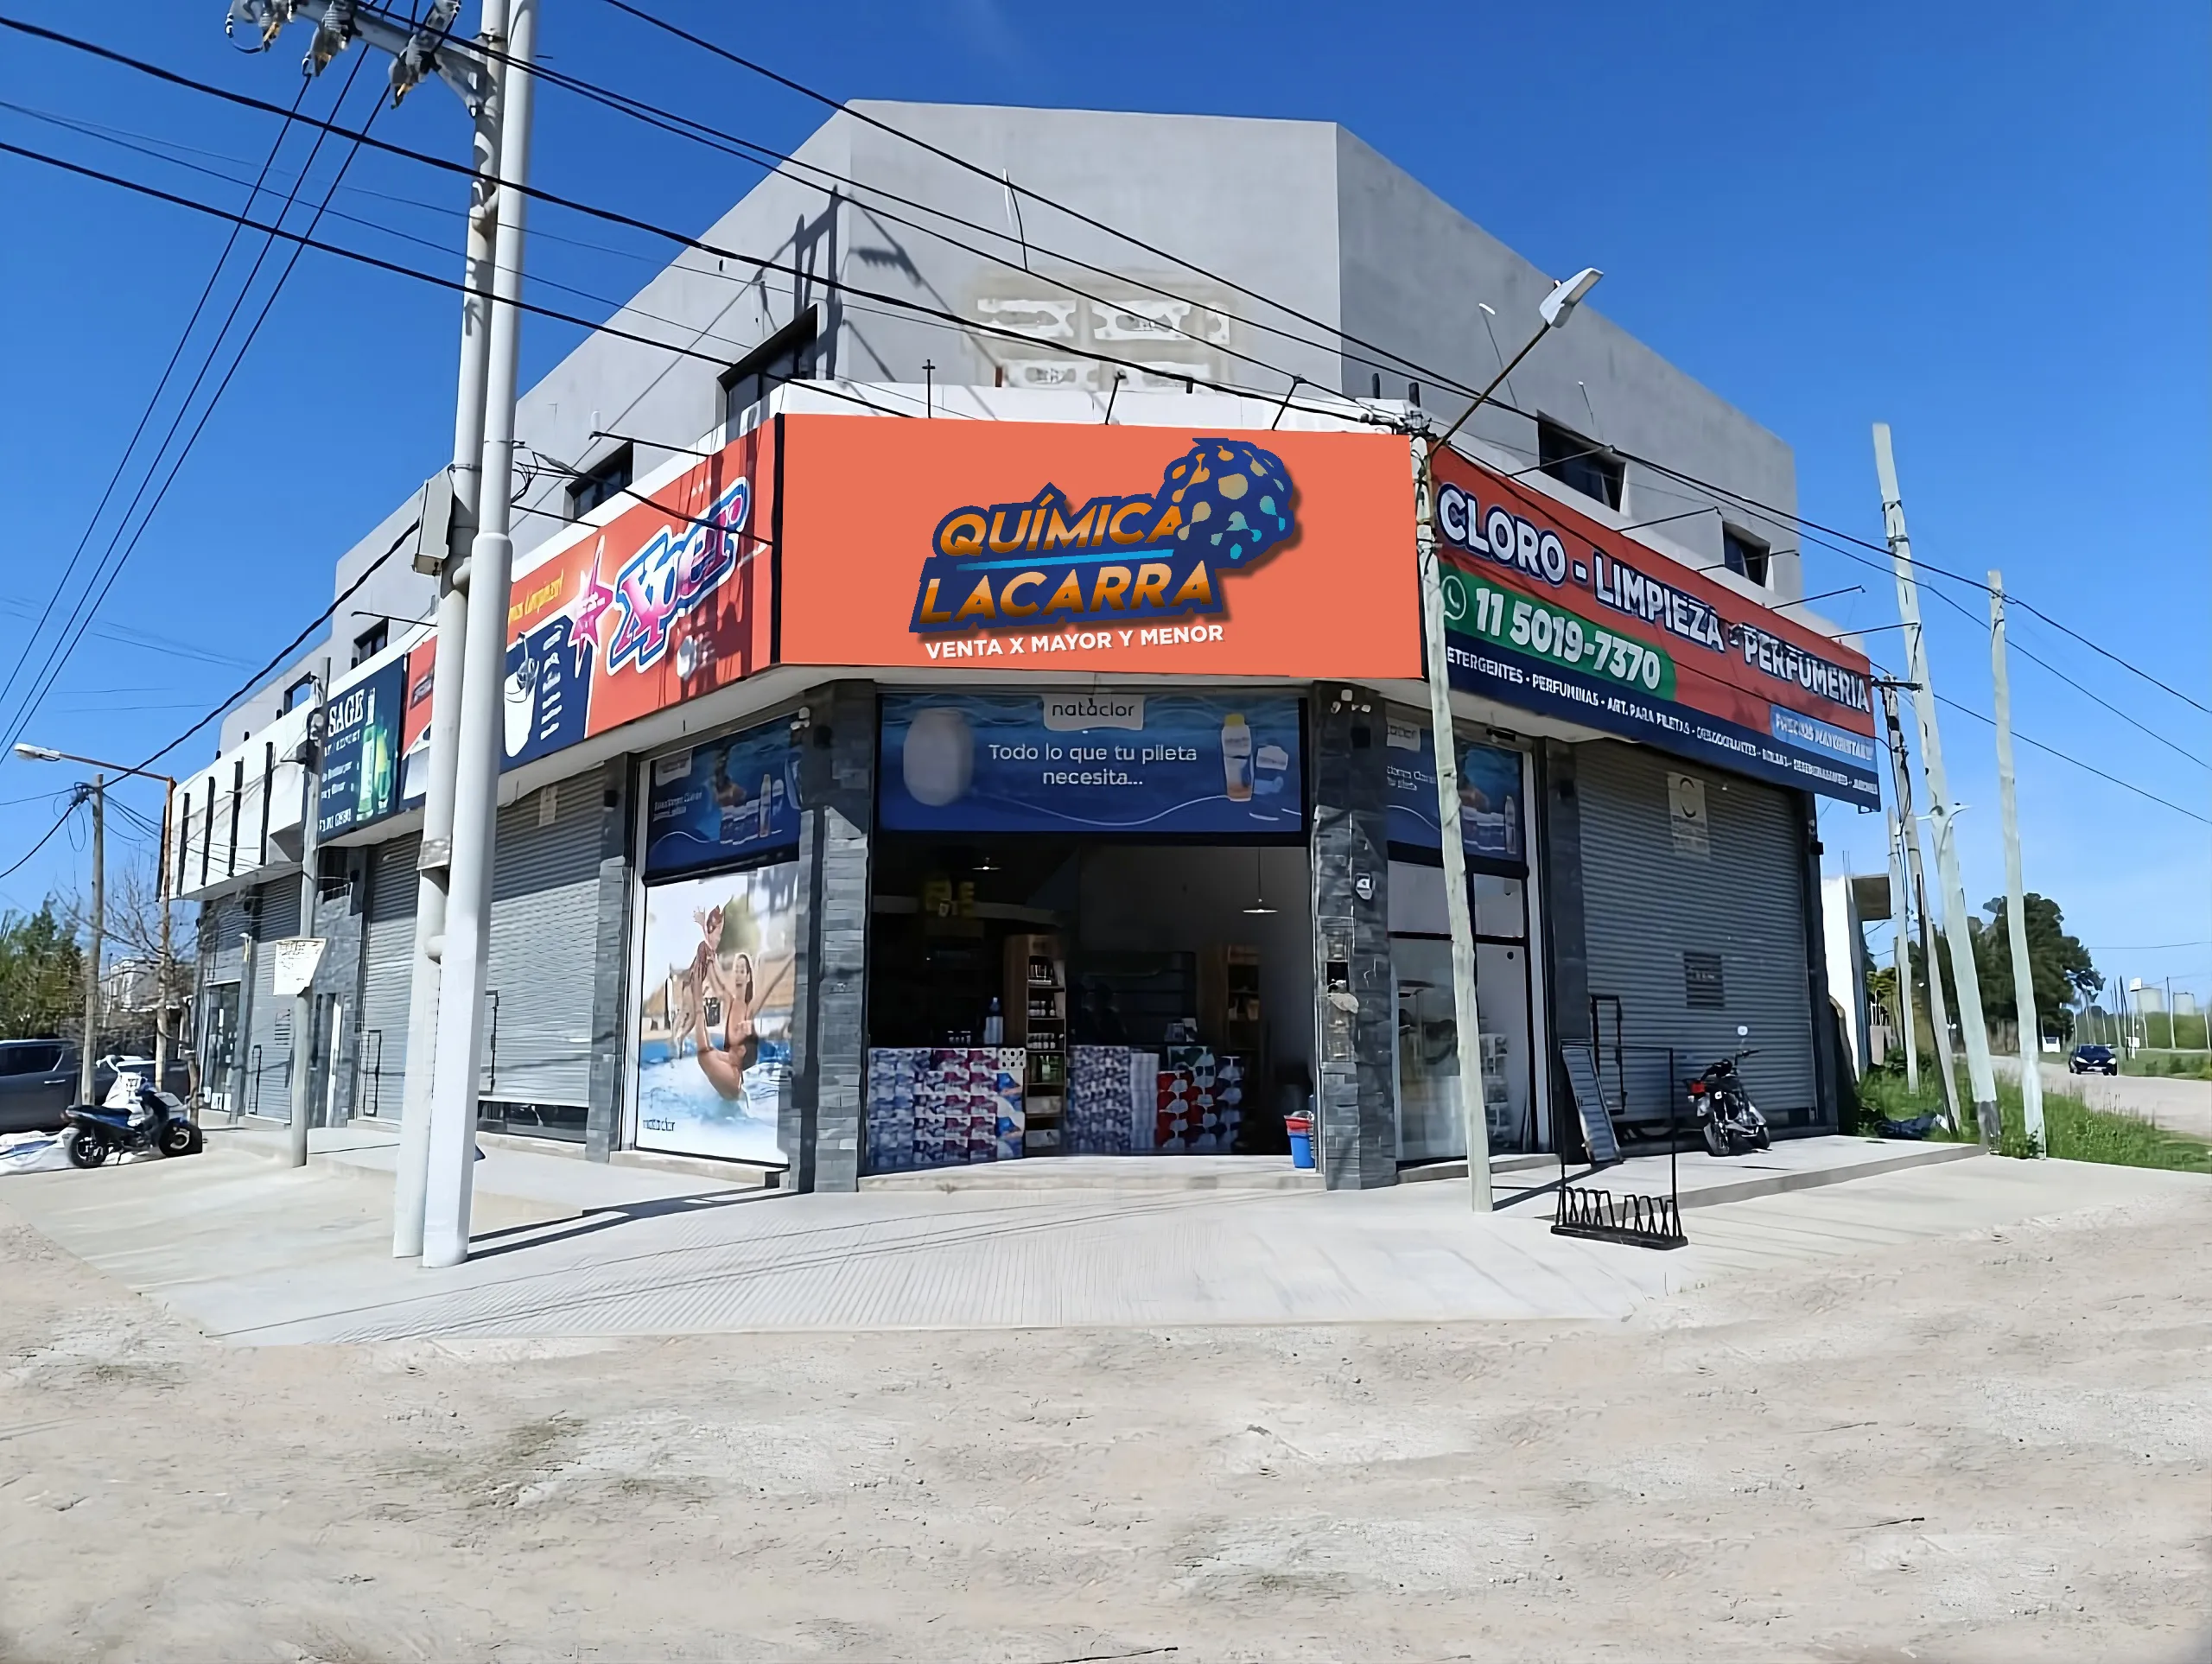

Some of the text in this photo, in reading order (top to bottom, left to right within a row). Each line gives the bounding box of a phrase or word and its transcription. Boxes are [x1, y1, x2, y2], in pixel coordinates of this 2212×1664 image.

[939, 493, 1183, 556] QUÍMICA
[918, 561, 1212, 625] LACARRA
[1439, 487, 1564, 582] CLORO
[1594, 553, 1726, 652] LIMPIEZA
[925, 625, 1224, 659] VENTA X MAYOR Y MENOR
[1476, 587, 1661, 690] 11 5019-7370
[1446, 646, 1523, 685] ETERGENTES
[988, 742, 1198, 765] Todo lo que tu pileta
[1042, 767, 1143, 785] necesita...
